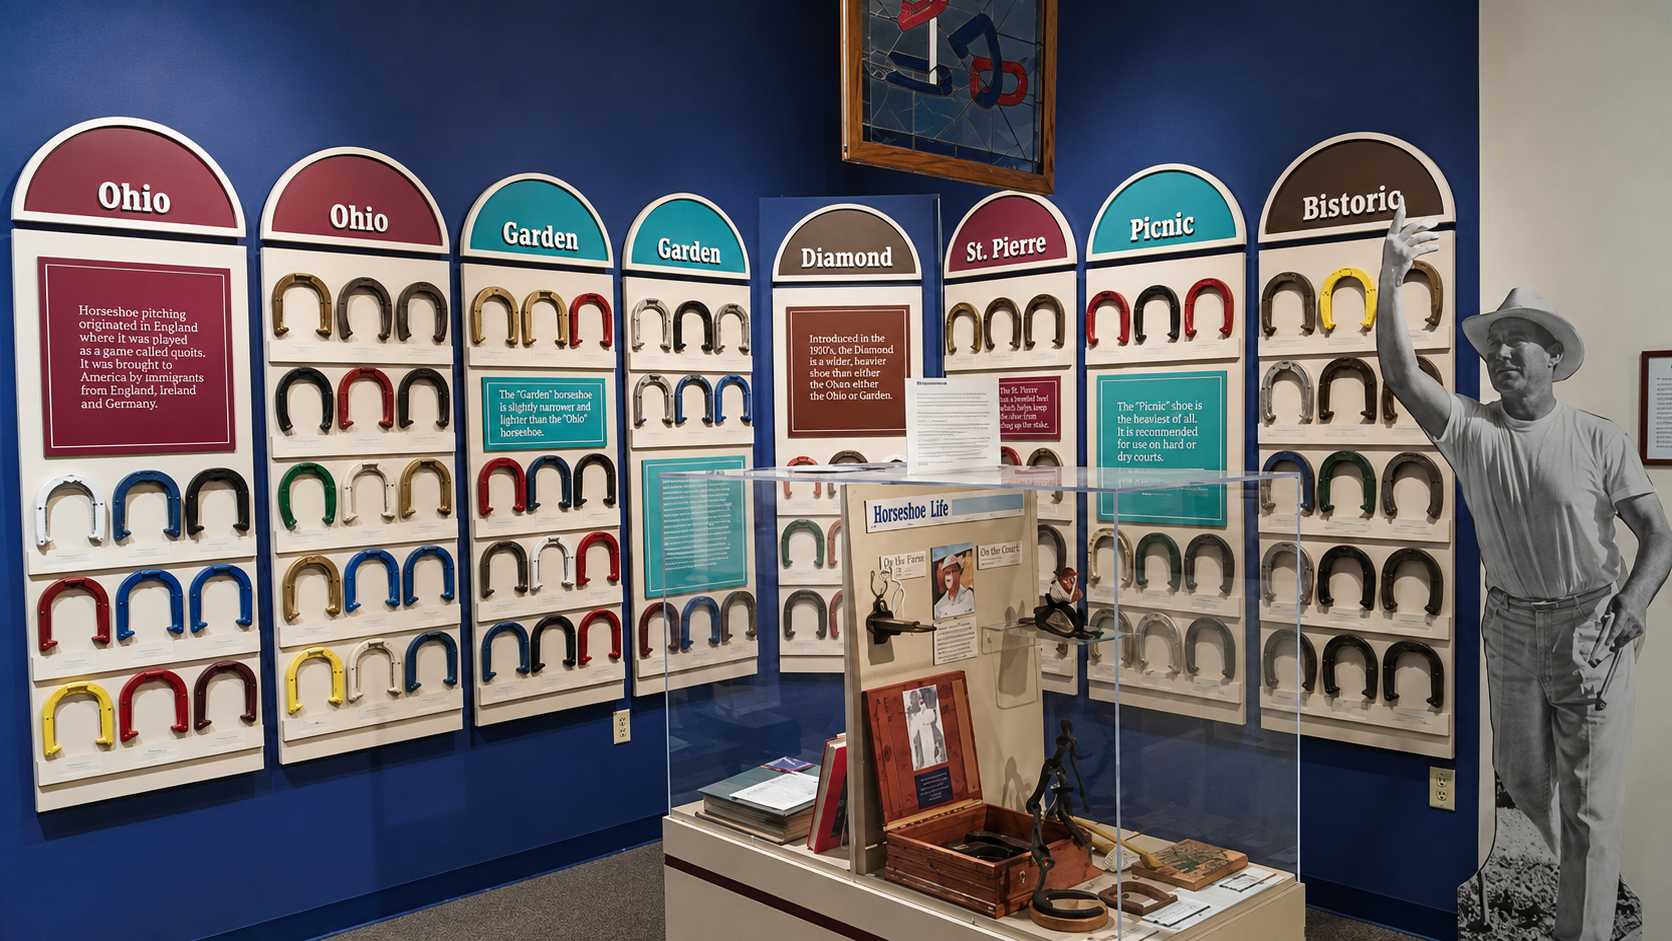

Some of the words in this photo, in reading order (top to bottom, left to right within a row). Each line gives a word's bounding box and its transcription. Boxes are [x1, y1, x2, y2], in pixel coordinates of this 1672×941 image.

[98, 181, 170, 214] Ohio
[1303, 185, 1402, 220] Bistoric
[330, 204, 388, 232] Ohio
[1130, 212, 1194, 241] Picnic
[503, 222, 578, 250] Garden
[658, 238, 721, 264] Garden
[966, 242, 987, 262] St.
[992, 236, 1046, 258] Pierre
[802, 246, 892, 268] Diamond
[79, 305, 138, 318] Horseshoe
[142, 308, 186, 322] pitching
[79, 319, 137, 332] originated
[140, 320, 151, 331] in
[154, 321, 198, 334] England
[80, 332, 114, 342] where
[118, 333, 126, 343] it
[128, 335, 150, 344] was
[152, 334, 188, 347] played
[810, 334, 858, 344] Introduced
[860, 334, 868, 342] in
[871, 334, 885, 342] the
[80, 348, 92, 356] as
[94, 348, 100, 356] a
[103, 348, 134, 358] game
[136, 346, 168, 357] called
[170, 348, 206, 360] quoits.
[838, 346, 852, 354] the
[854, 345, 894, 354] Diamond
[80, 359, 88, 368] It
[92, 360, 113, 369] was
[116, 359, 159, 372] brought
[162, 361, 172, 370] to
[810, 358, 817, 366] is
[80, 372, 126, 382] America
[130, 372, 142, 384] by
[146, 372, 204, 384] immigrants
[832, 368, 852, 378] than
[854, 368, 880, 378] either
[810, 380, 824, 388] the
[81, 385, 108, 395] from
[110, 385, 157, 398] England,
[160, 384, 196, 395] Ireland
[499, 390, 514, 399] The
[810, 391, 824, 400] the
[826, 391, 846, 400] Ohio
[860, 391, 893, 400] Garden.
[81, 398, 102, 408] and
[106, 399, 158, 410] Germany.
[500, 402, 506, 412] is
[508, 402, 538, 414] slightly
[576, 402, 591, 411] and
[1117, 402, 1134, 411] The
[1172, 400, 1193, 410] shoe
[1195, 400, 1202, 410] is
[529, 414, 547, 424] than
[549, 414, 562, 424] the
[1118, 414, 1132, 424] the
[1134, 414, 1170, 424] heaviest
[1172, 414, 1182, 424] of
[1184, 413, 1198, 424] all.
[1118, 427, 1125, 436] It
[1126, 426, 1134, 436] is
[1118, 438, 1130, 448] for
[1163, 438, 1184, 449] hard
[1118, 451, 1132, 464] dry
[1134, 453, 1164, 462] courts.
[874, 502, 926, 524] Horseshoe
[930, 499, 948, 518] Life
